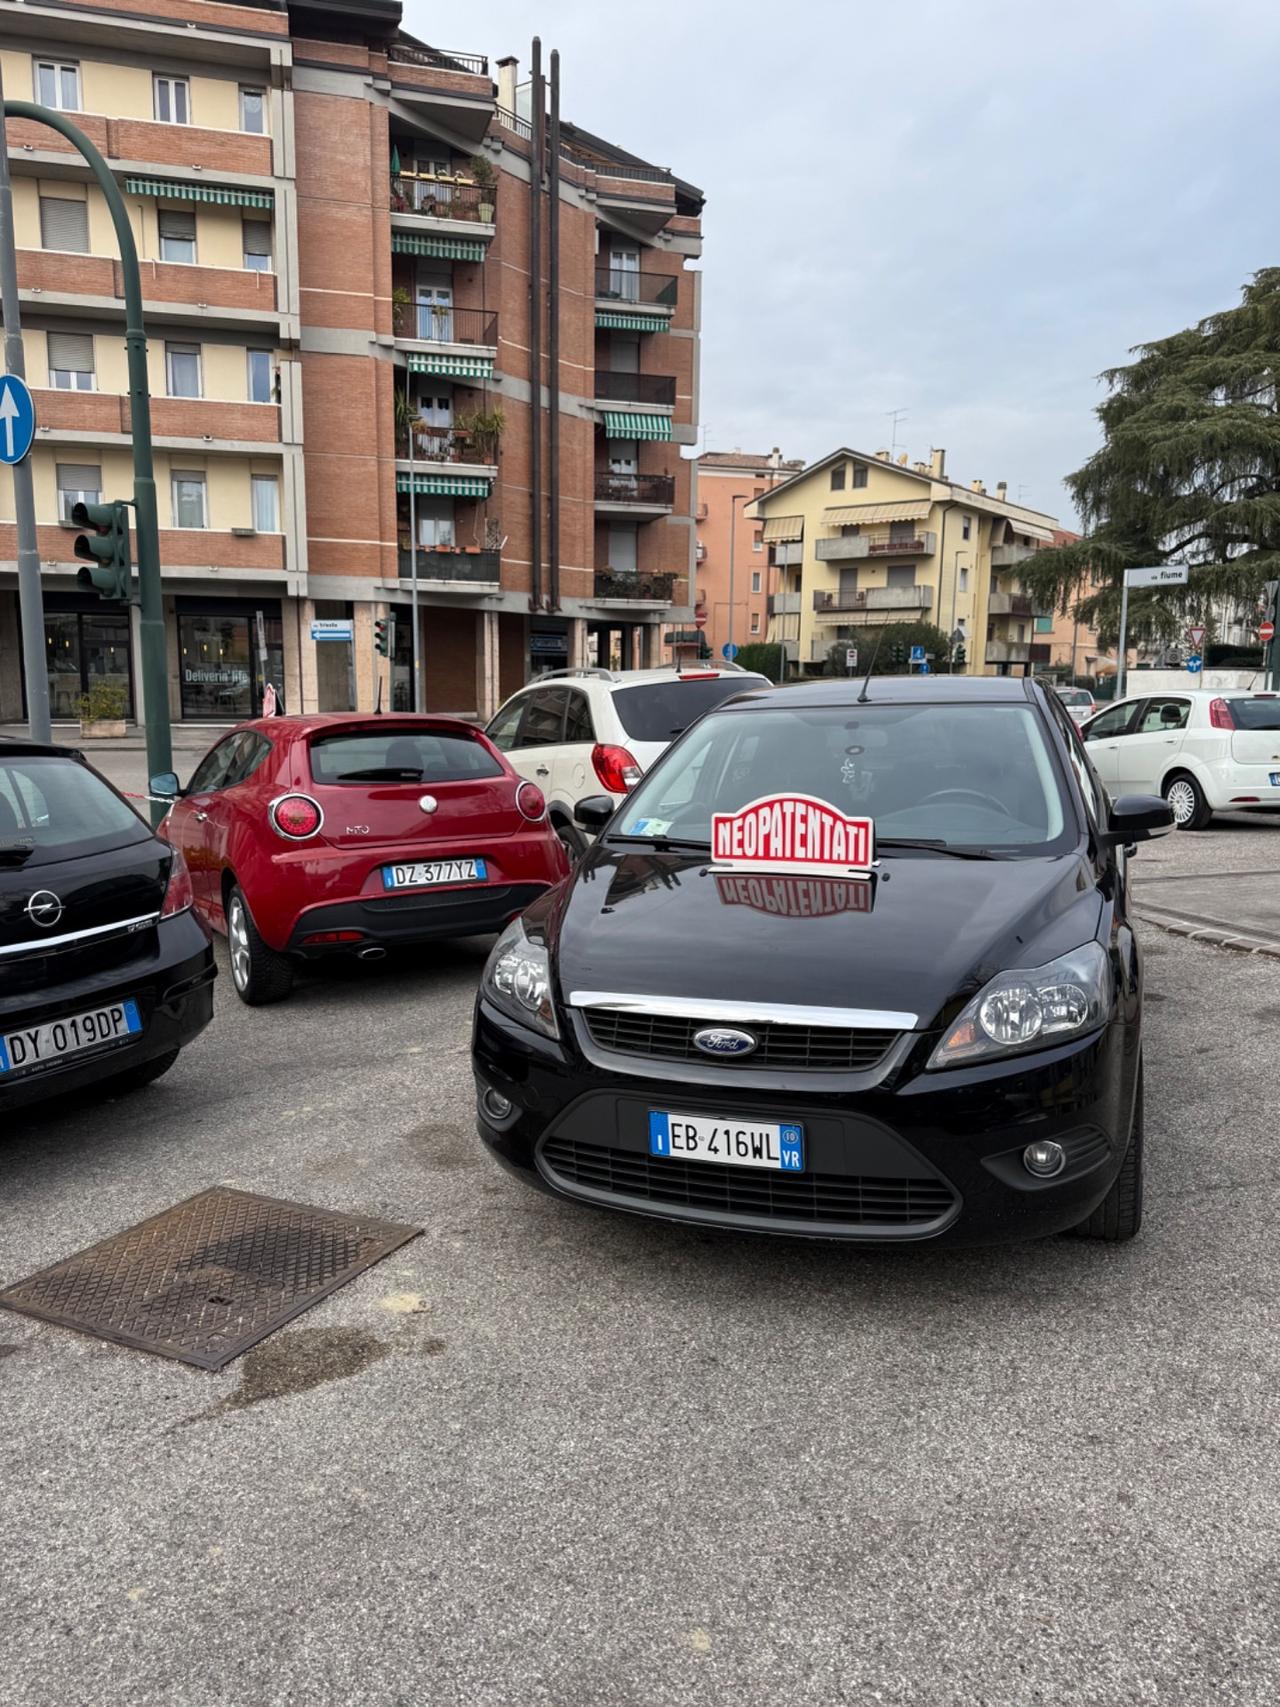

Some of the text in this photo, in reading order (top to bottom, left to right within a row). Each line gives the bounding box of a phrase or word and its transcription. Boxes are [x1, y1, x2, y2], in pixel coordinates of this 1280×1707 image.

[1160, 571, 1183, 580] fiume
[718, 801, 866, 862] NEOPATENTATI
[396, 866, 418, 884] DZ
[424, 861, 475, 882] 377YZ
[9, 1029, 41, 1065] DY
[52, 1007, 123, 1051] 019DP
[707, 1033, 740, 1050] Ford
[671, 1123, 698, 1151] EB
[707, 1128, 780, 1160] 416WL
[782, 1150, 800, 1168] VR
